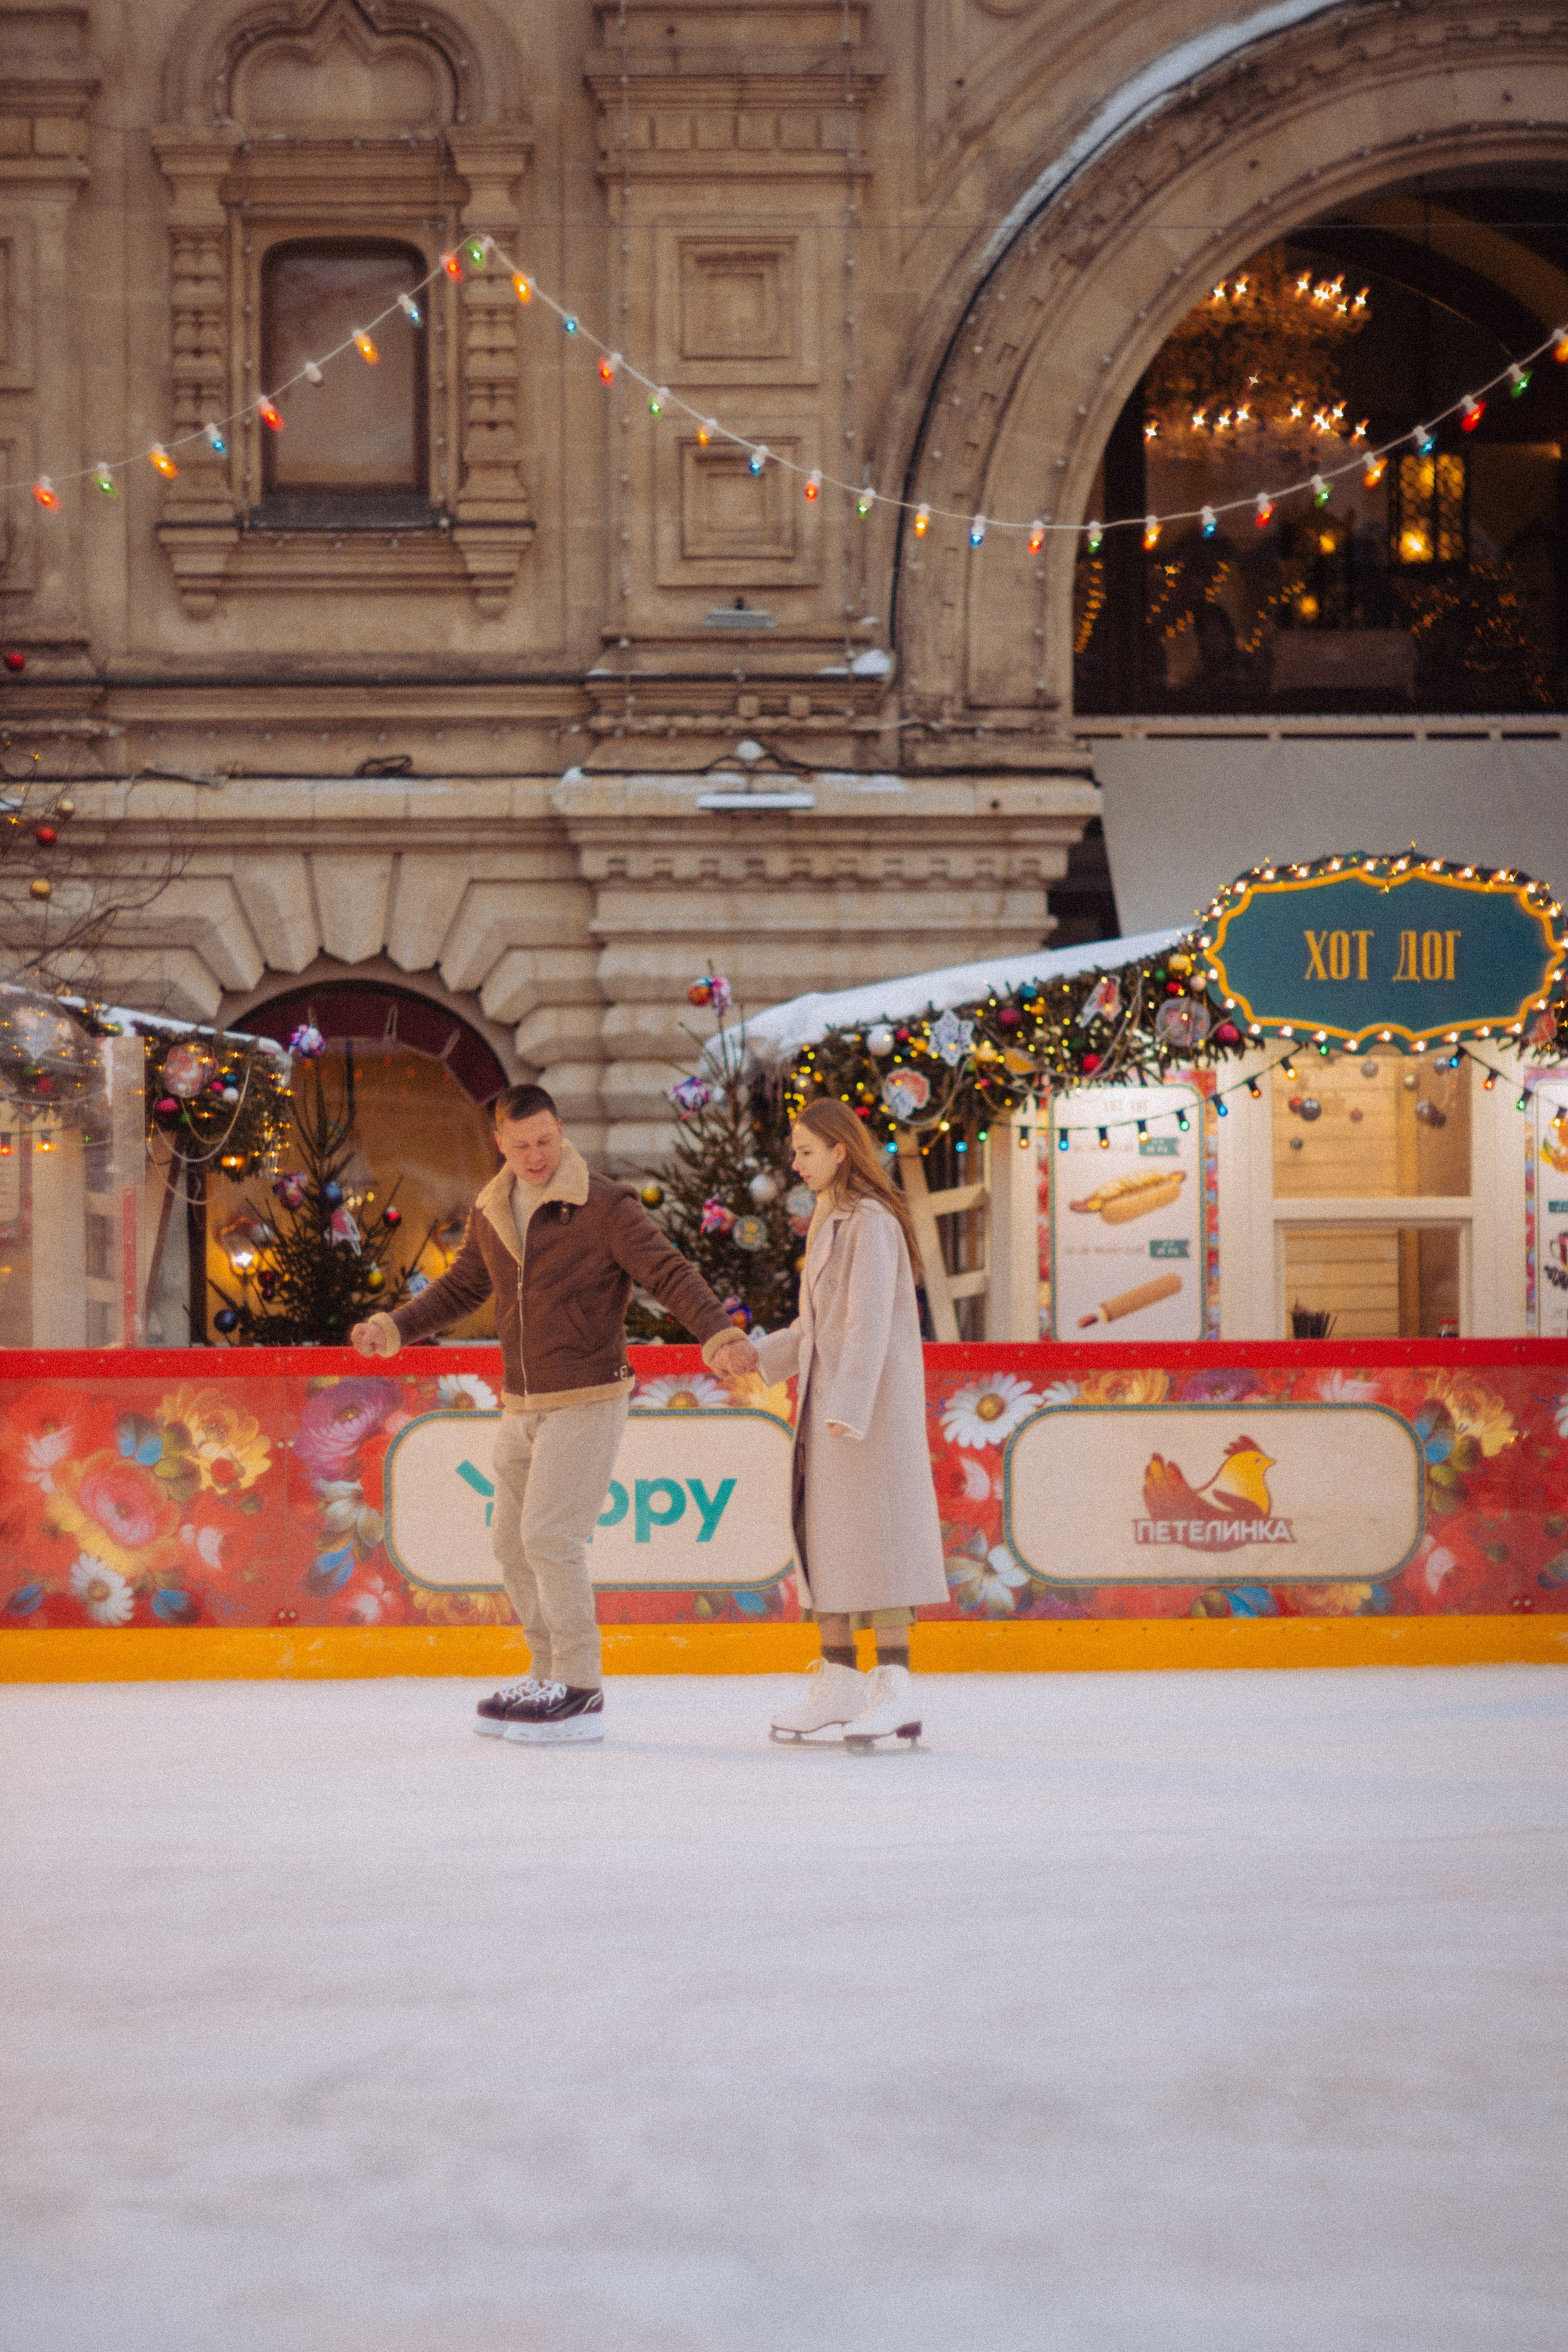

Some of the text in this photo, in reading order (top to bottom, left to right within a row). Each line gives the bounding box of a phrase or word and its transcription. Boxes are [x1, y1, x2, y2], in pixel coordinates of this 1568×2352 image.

[1304, 930, 1462, 983] ХОТ ДОГ
[1137, 1520, 1291, 1542] ПЕТЕЛИНКА
